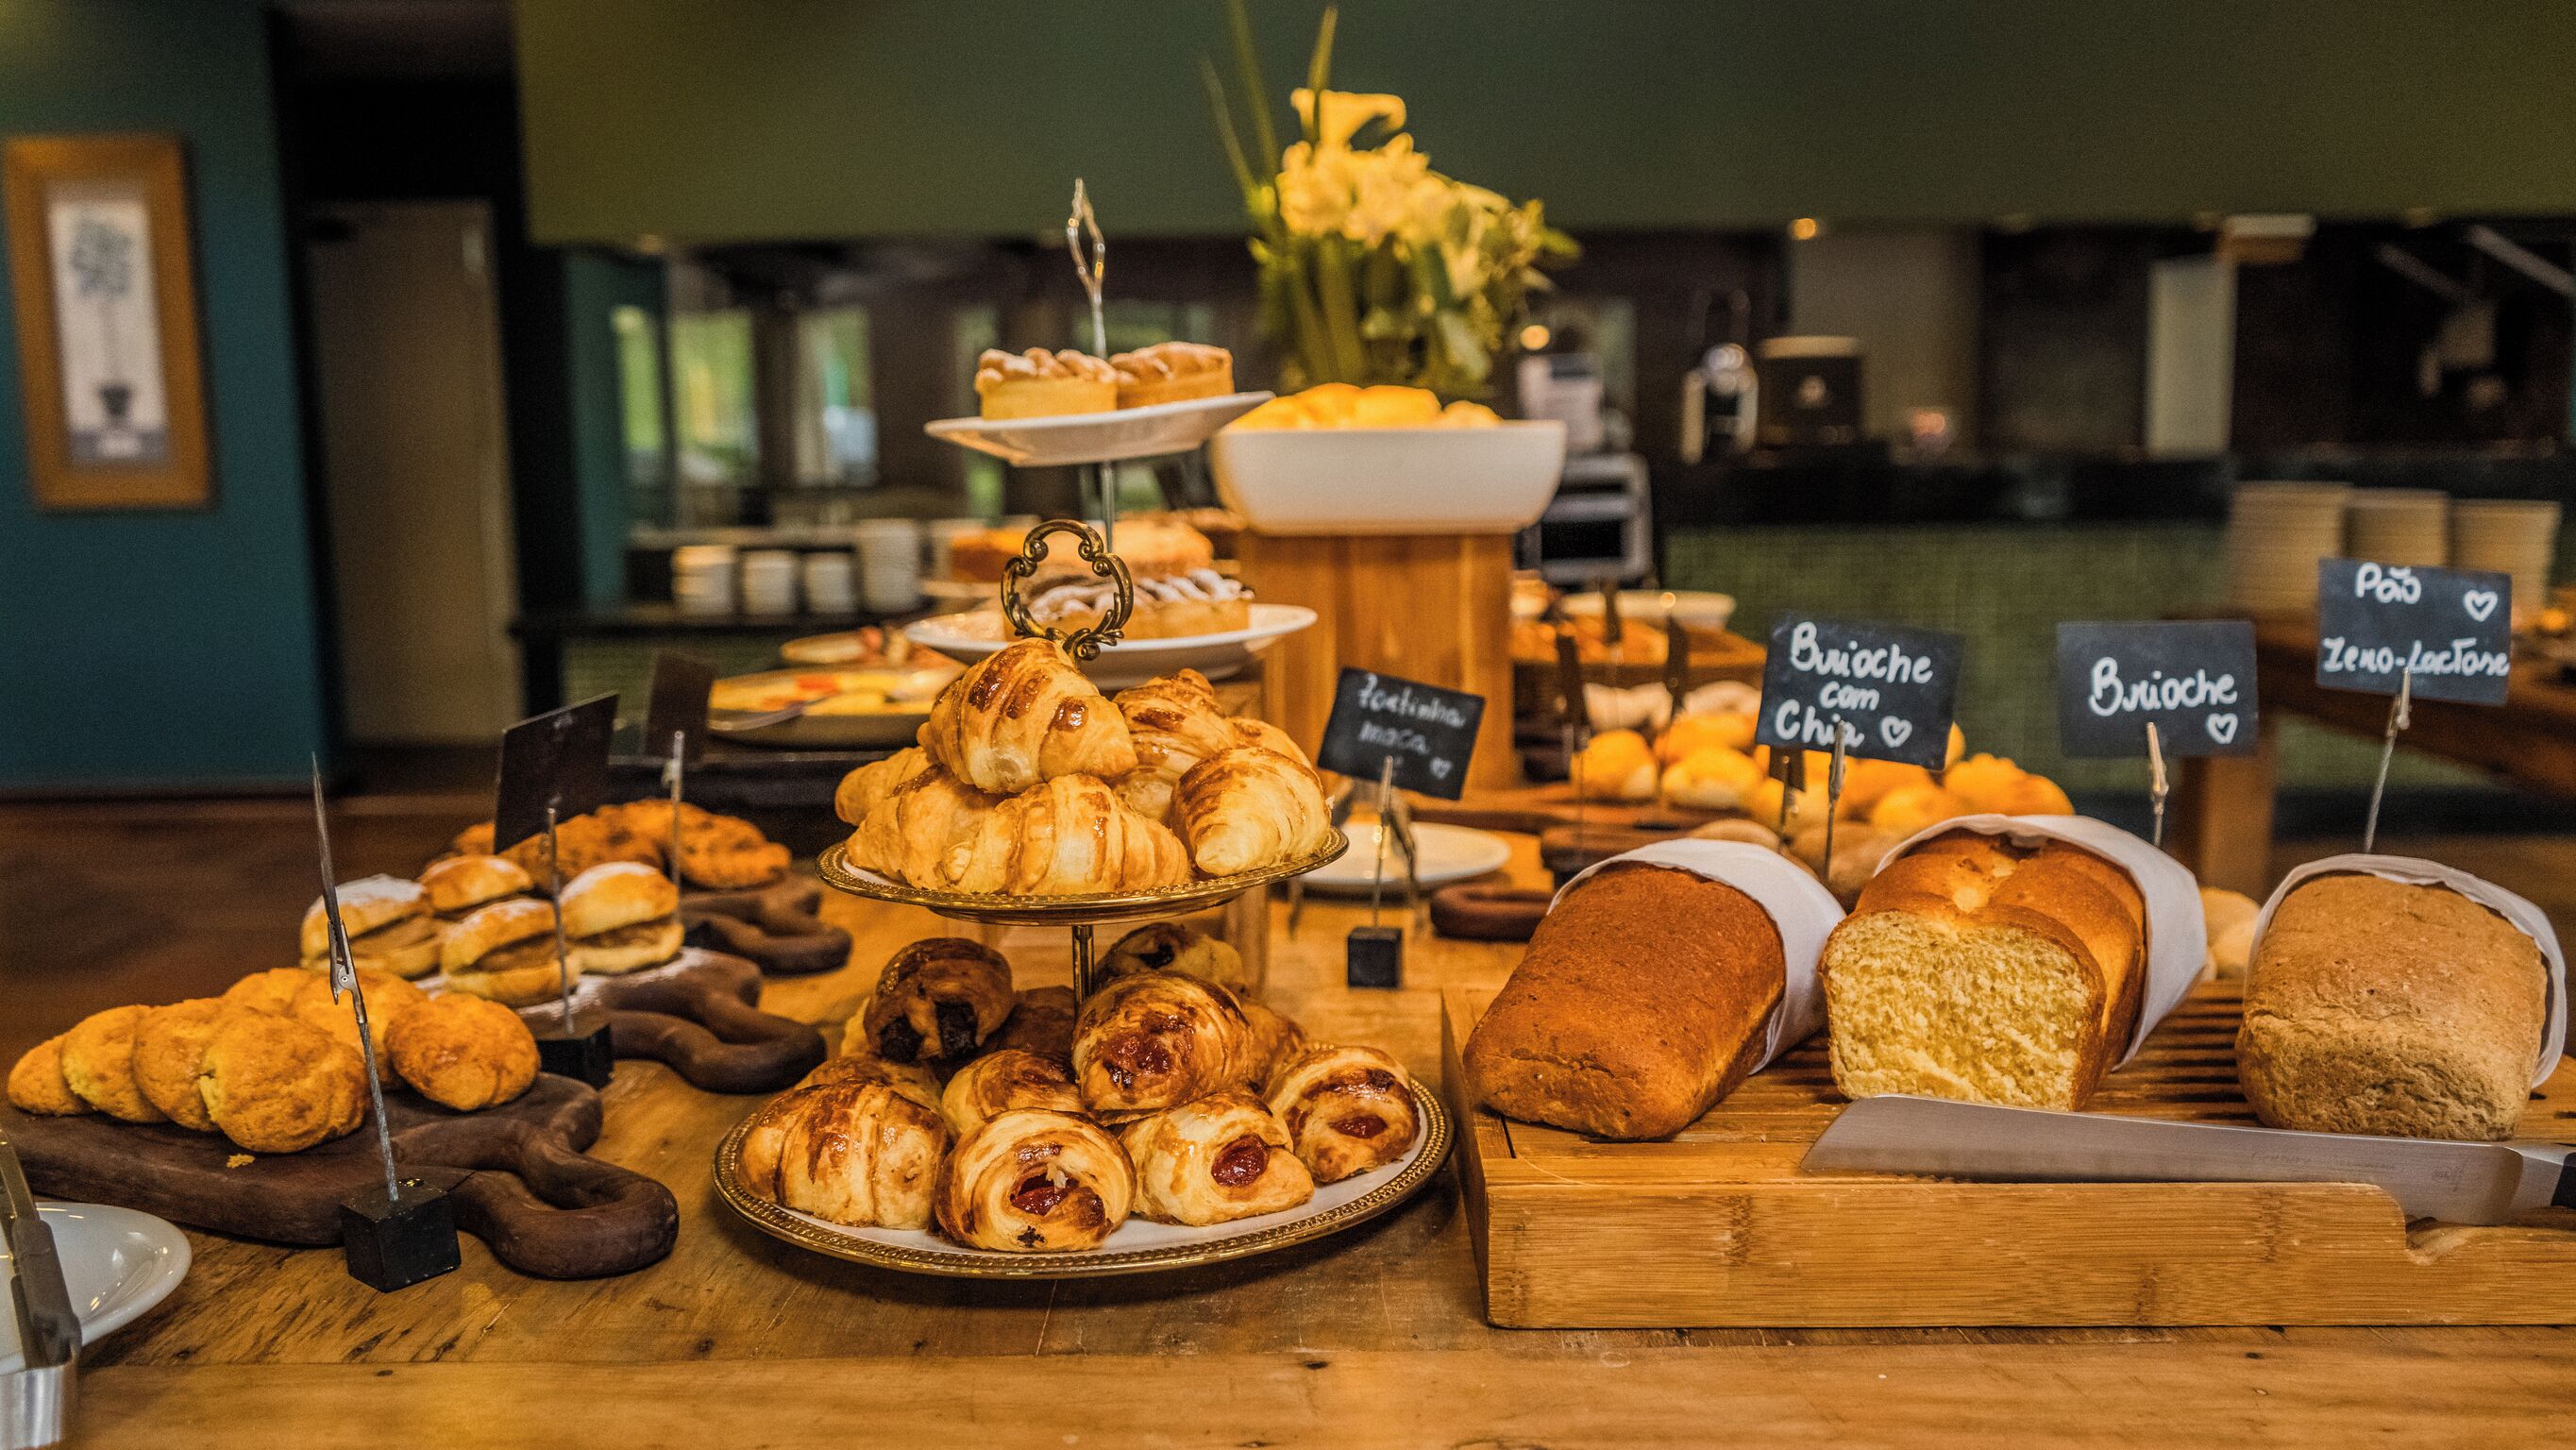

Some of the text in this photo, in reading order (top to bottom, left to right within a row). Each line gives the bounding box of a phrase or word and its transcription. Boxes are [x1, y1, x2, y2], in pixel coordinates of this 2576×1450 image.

[2355, 562, 2422, 604] Pão
[1792, 621, 1934, 683] Brioche
[1820, 681, 1880, 710] com
[2088, 657, 2238, 717] Brioche
[1776, 699, 1865, 748] Chia
